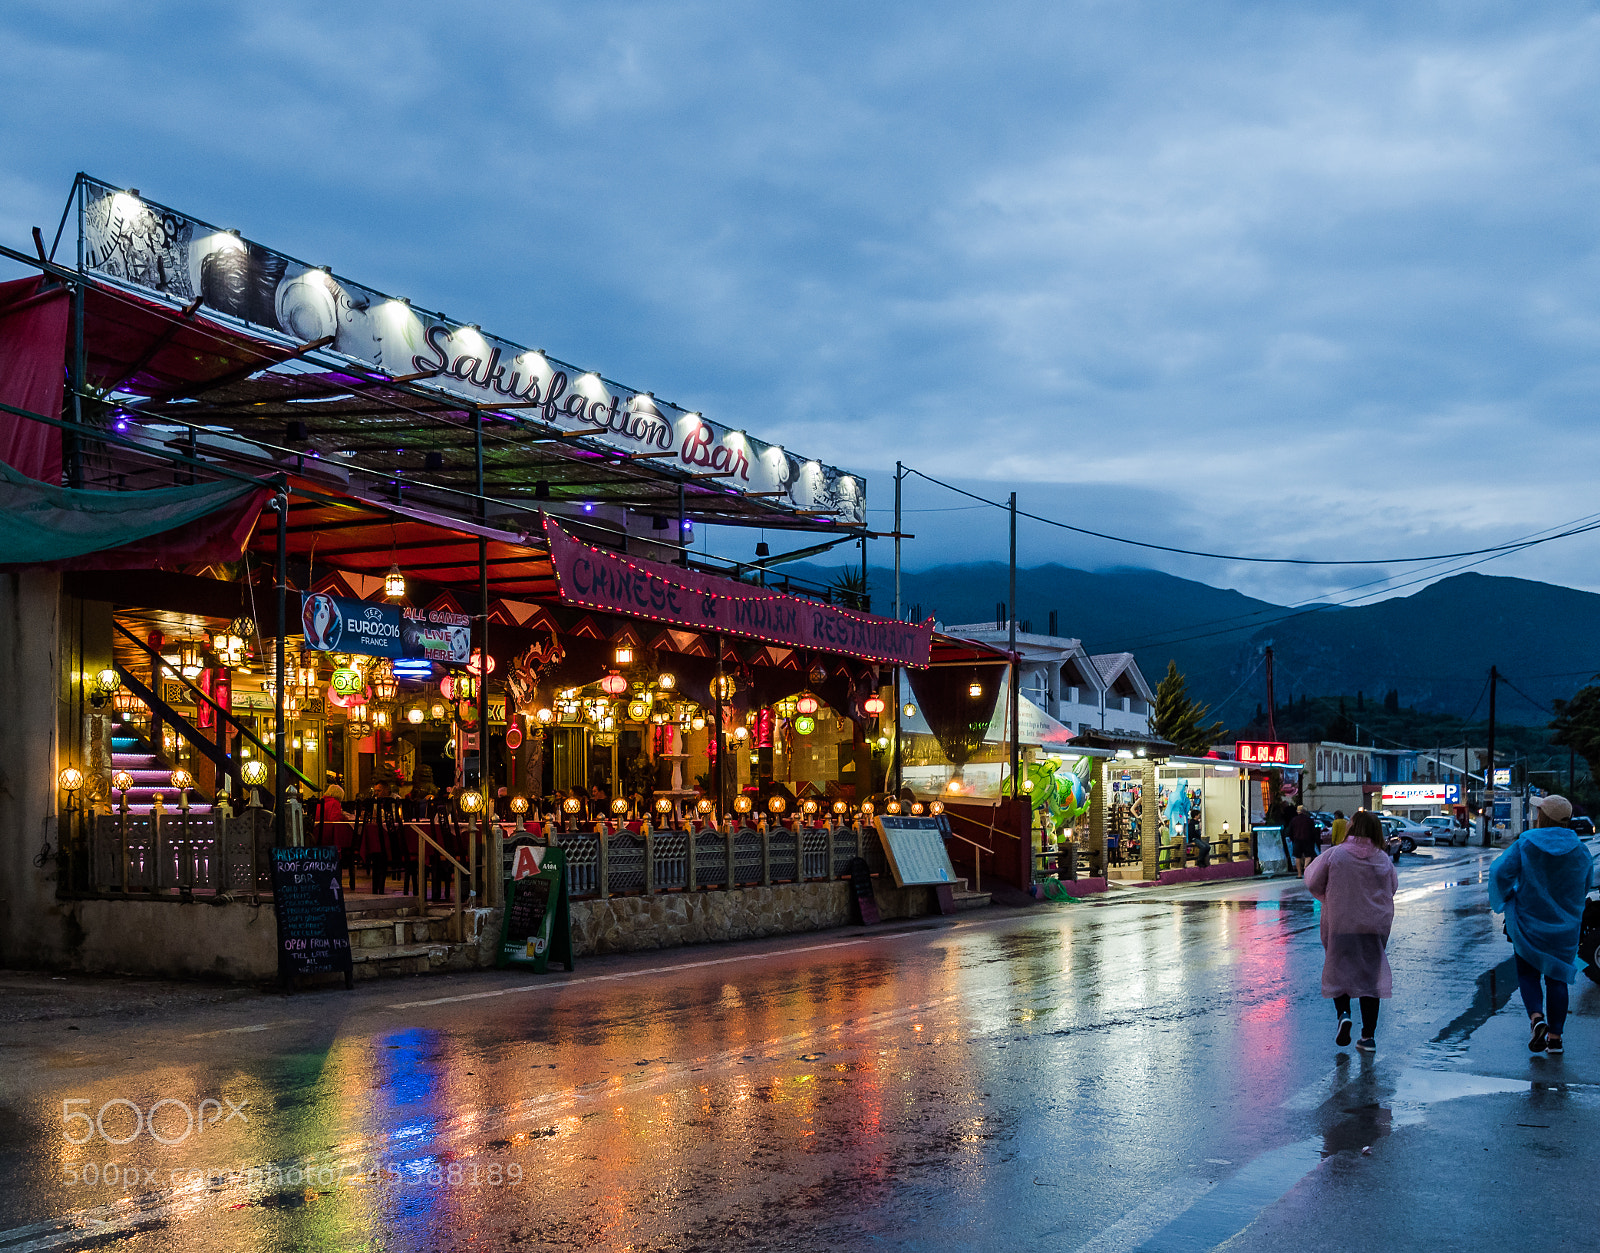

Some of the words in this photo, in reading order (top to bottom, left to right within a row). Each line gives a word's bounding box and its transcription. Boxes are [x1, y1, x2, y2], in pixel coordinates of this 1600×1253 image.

[412, 325, 673, 450] Sakisfaction
[681, 421, 749, 481] Bar
[364, 607, 384, 622] UEFA
[572, 558, 682, 615] CHINESE
[701, 586, 717, 619] &
[734, 599, 797, 635] INDIAN
[812, 611, 917, 657] RESTAURANT
[403, 607, 426, 622] ALL
[428, 611, 470, 626] GAMES
[347, 618, 400, 638] EURO2016
[424, 628, 452, 642] LIVE
[360, 636, 389, 647] FRANCE
[424, 648, 454, 661] HERE
[1394, 789, 1435, 799] express
[1446, 785, 1457, 799] P
[277, 861, 301, 873] ROOF
[303, 861, 338, 872] GARDEN
[294, 873, 315, 884] BAR
[284, 938, 308, 951] OPEN
[310, 938, 331, 949] FROM
